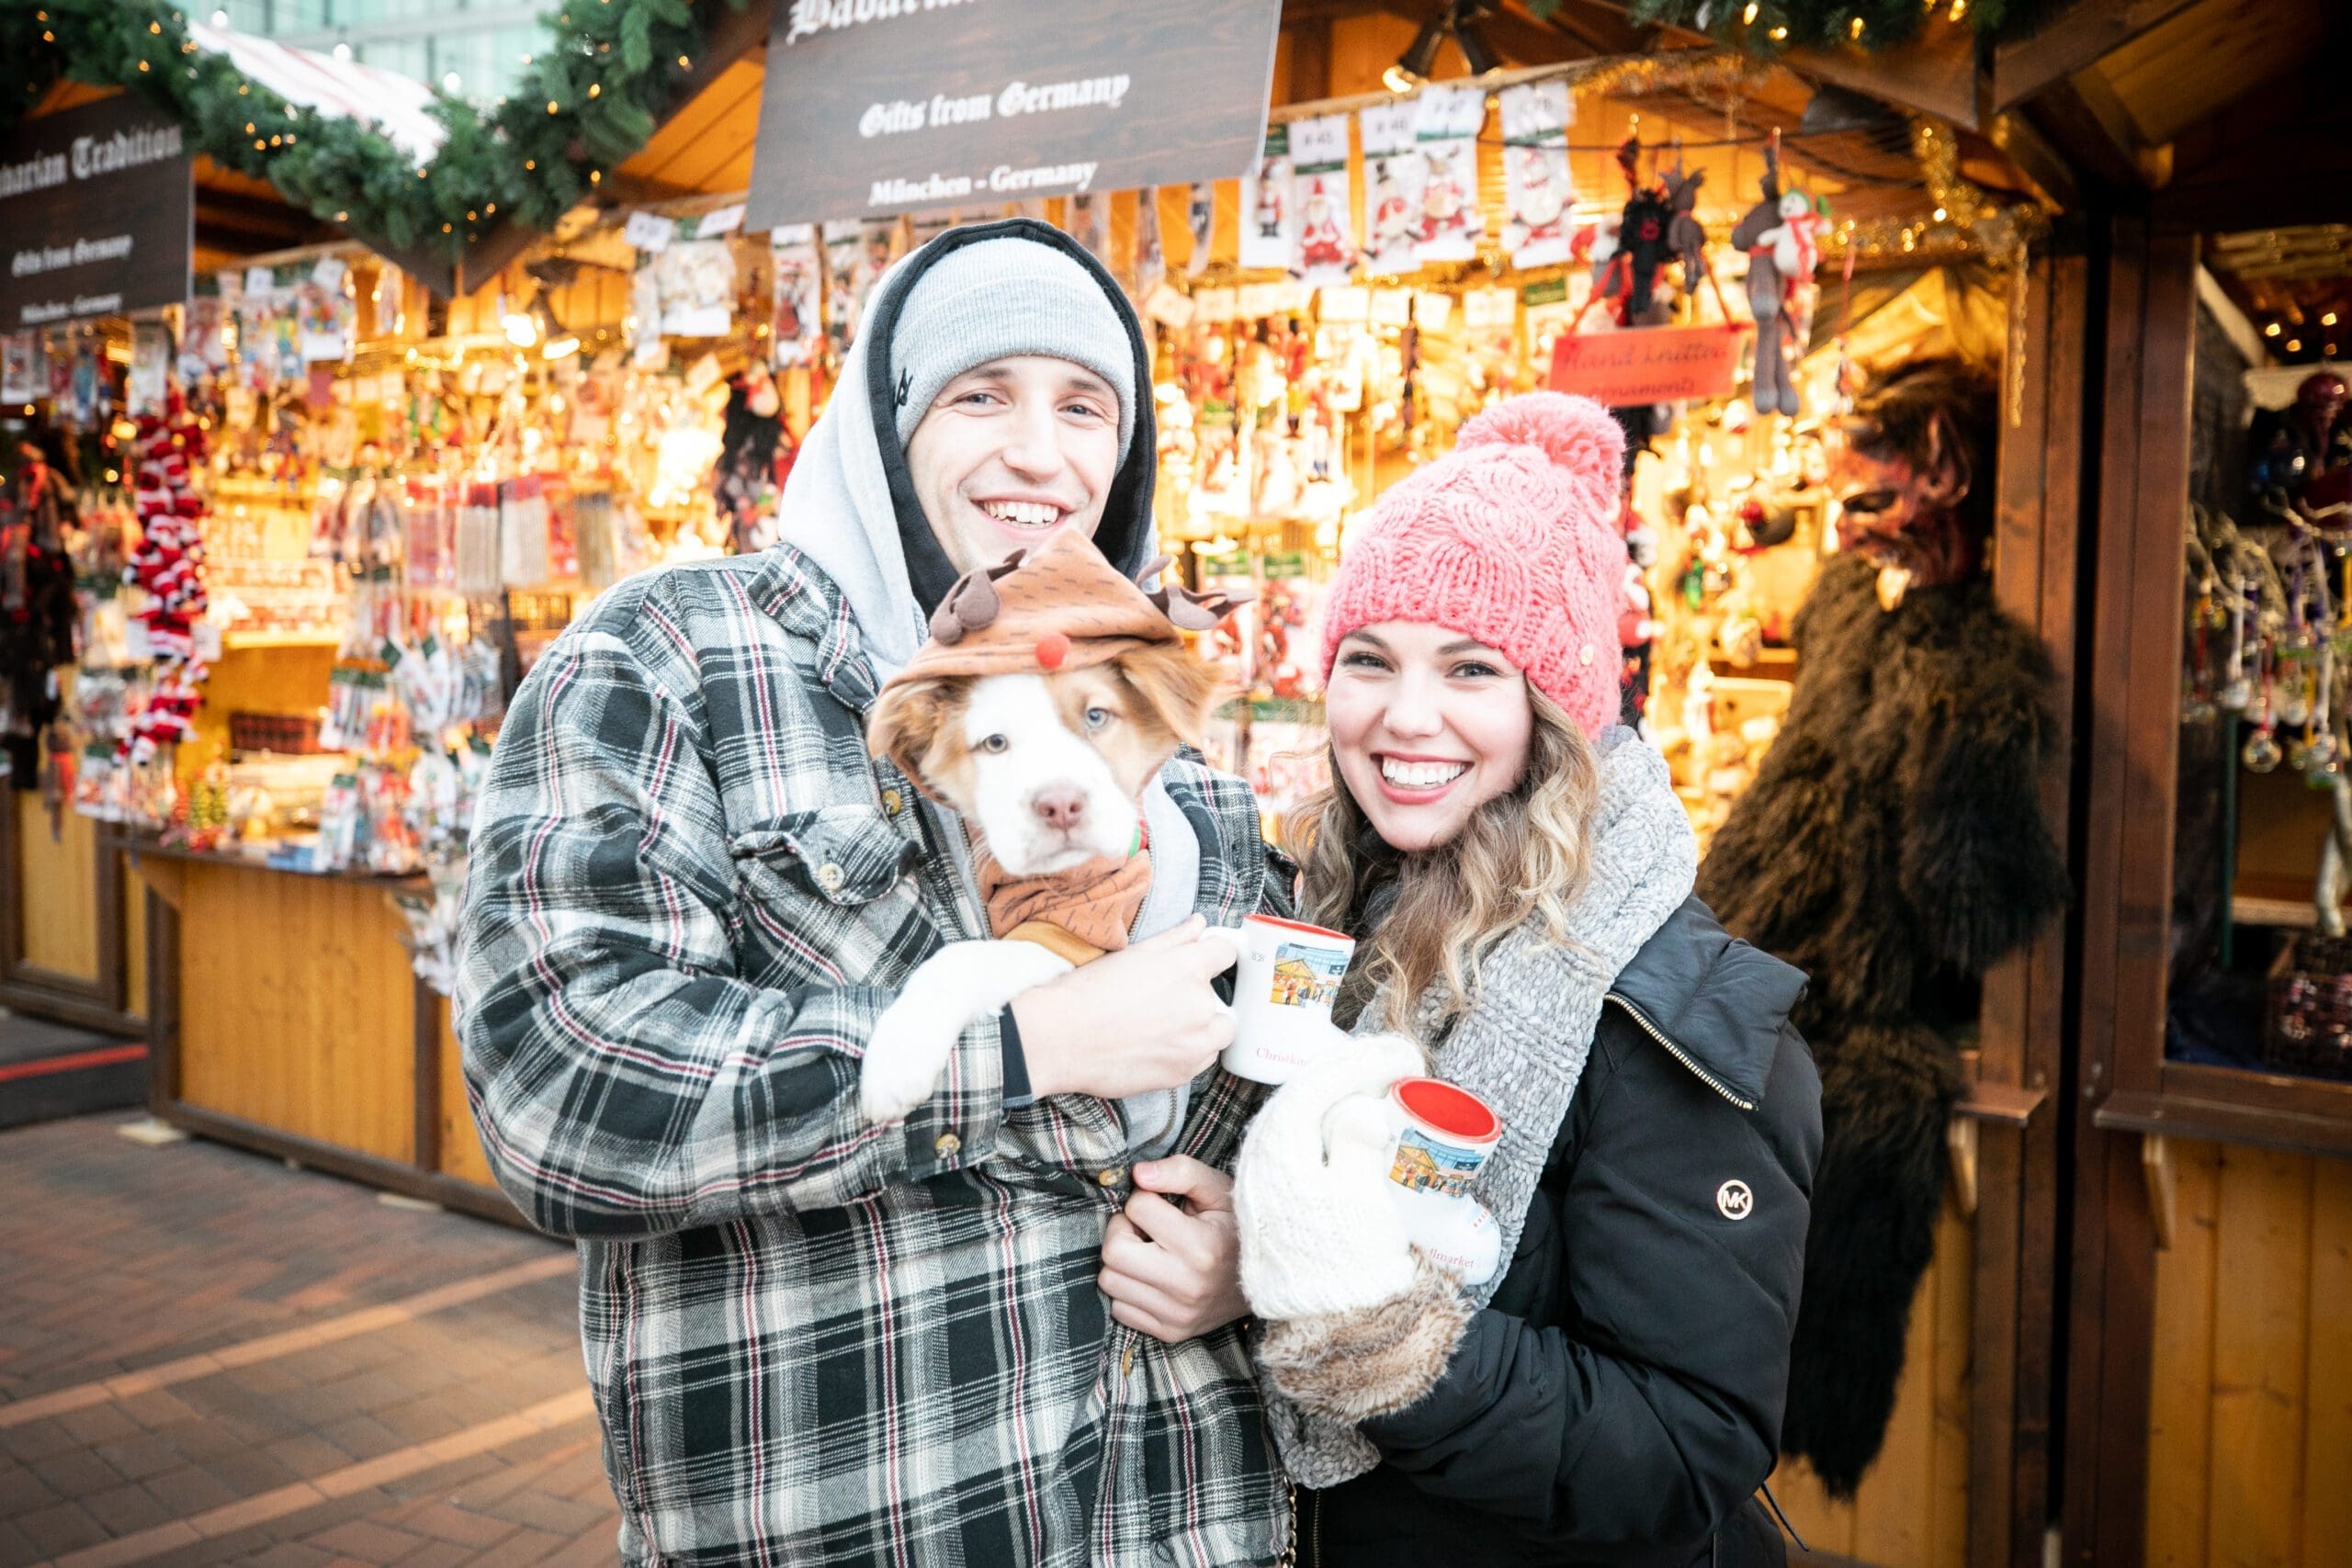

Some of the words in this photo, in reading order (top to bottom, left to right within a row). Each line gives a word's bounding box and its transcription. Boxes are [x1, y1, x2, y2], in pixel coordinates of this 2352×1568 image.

[859, 99, 927, 138] Gifts
[929, 94, 992, 127] from
[997, 74, 1130, 118] Germany
[989, 160, 1098, 192] Germany
